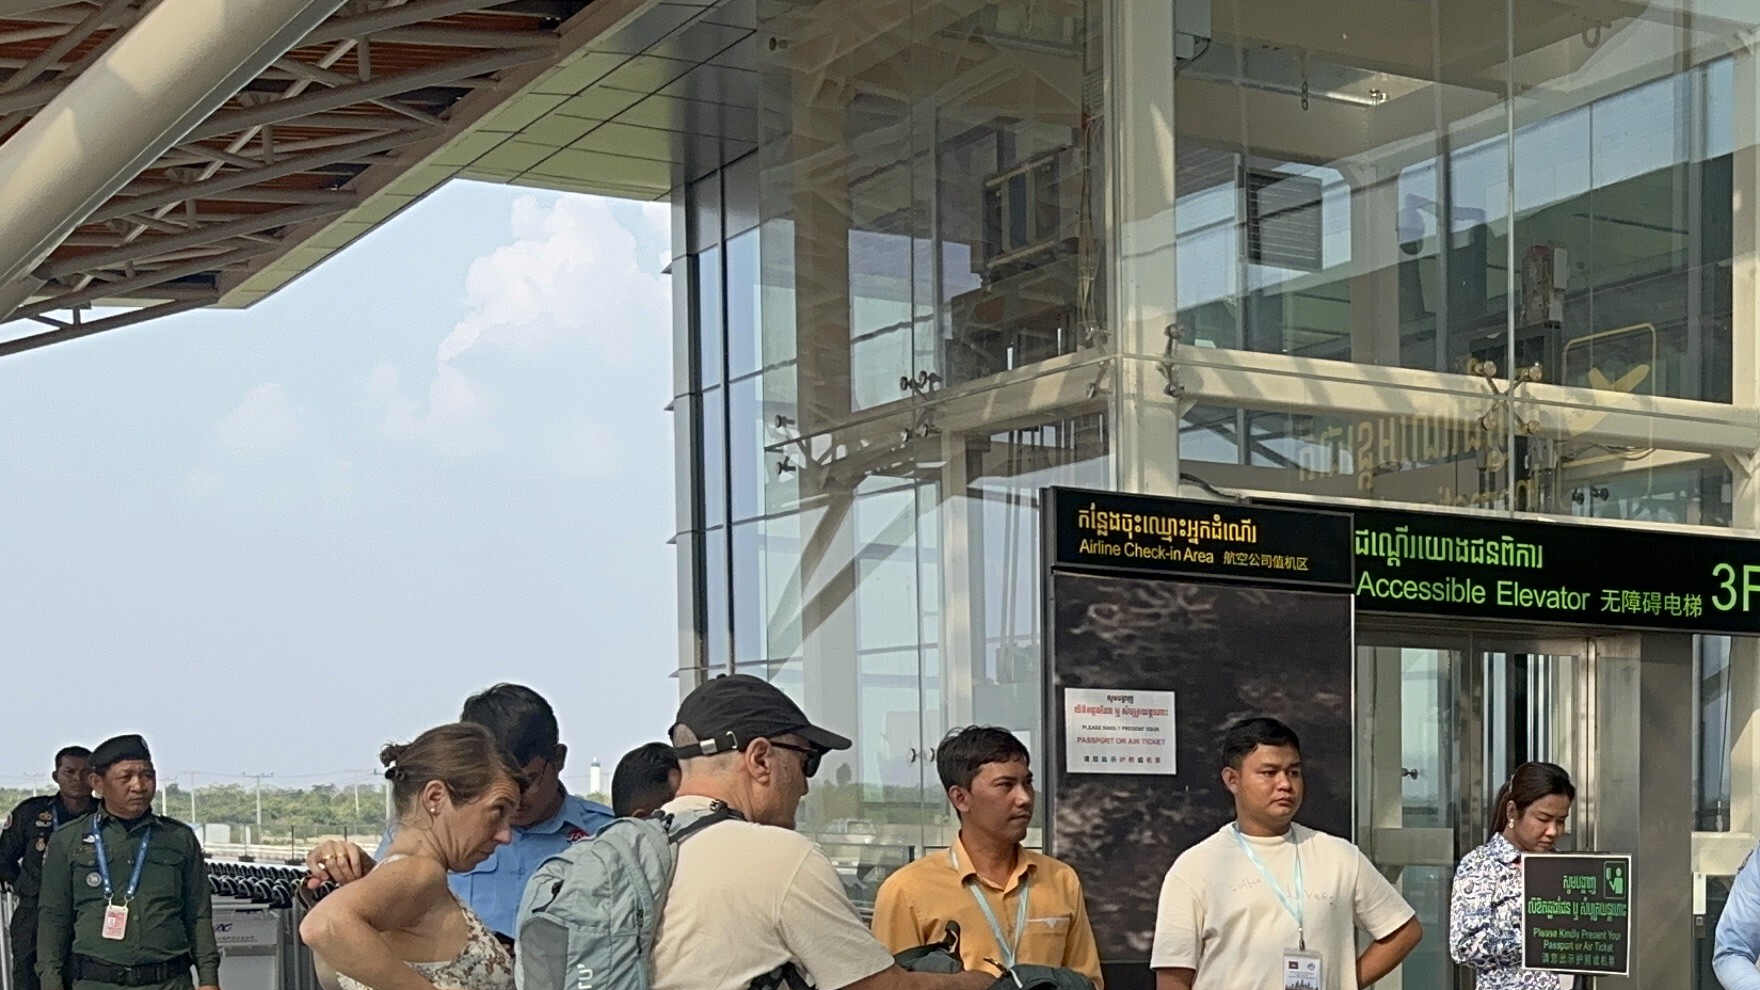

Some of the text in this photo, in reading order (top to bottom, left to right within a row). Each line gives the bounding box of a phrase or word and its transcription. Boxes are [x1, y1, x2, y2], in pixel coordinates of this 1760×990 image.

[1079, 538, 1214, 564] Airline Check-in Area
[1223, 550, 1309, 571] 航空公司值机区
[1356, 570, 1590, 611] Accessible Elevator
[1601, 590, 1703, 618] 无障碍电梯
[1077, 737, 1114, 745] PASSPORT
[1142, 738, 1166, 746] TICKET
[1533, 927, 1557, 938] Please
[1543, 940, 1573, 951] Passport
